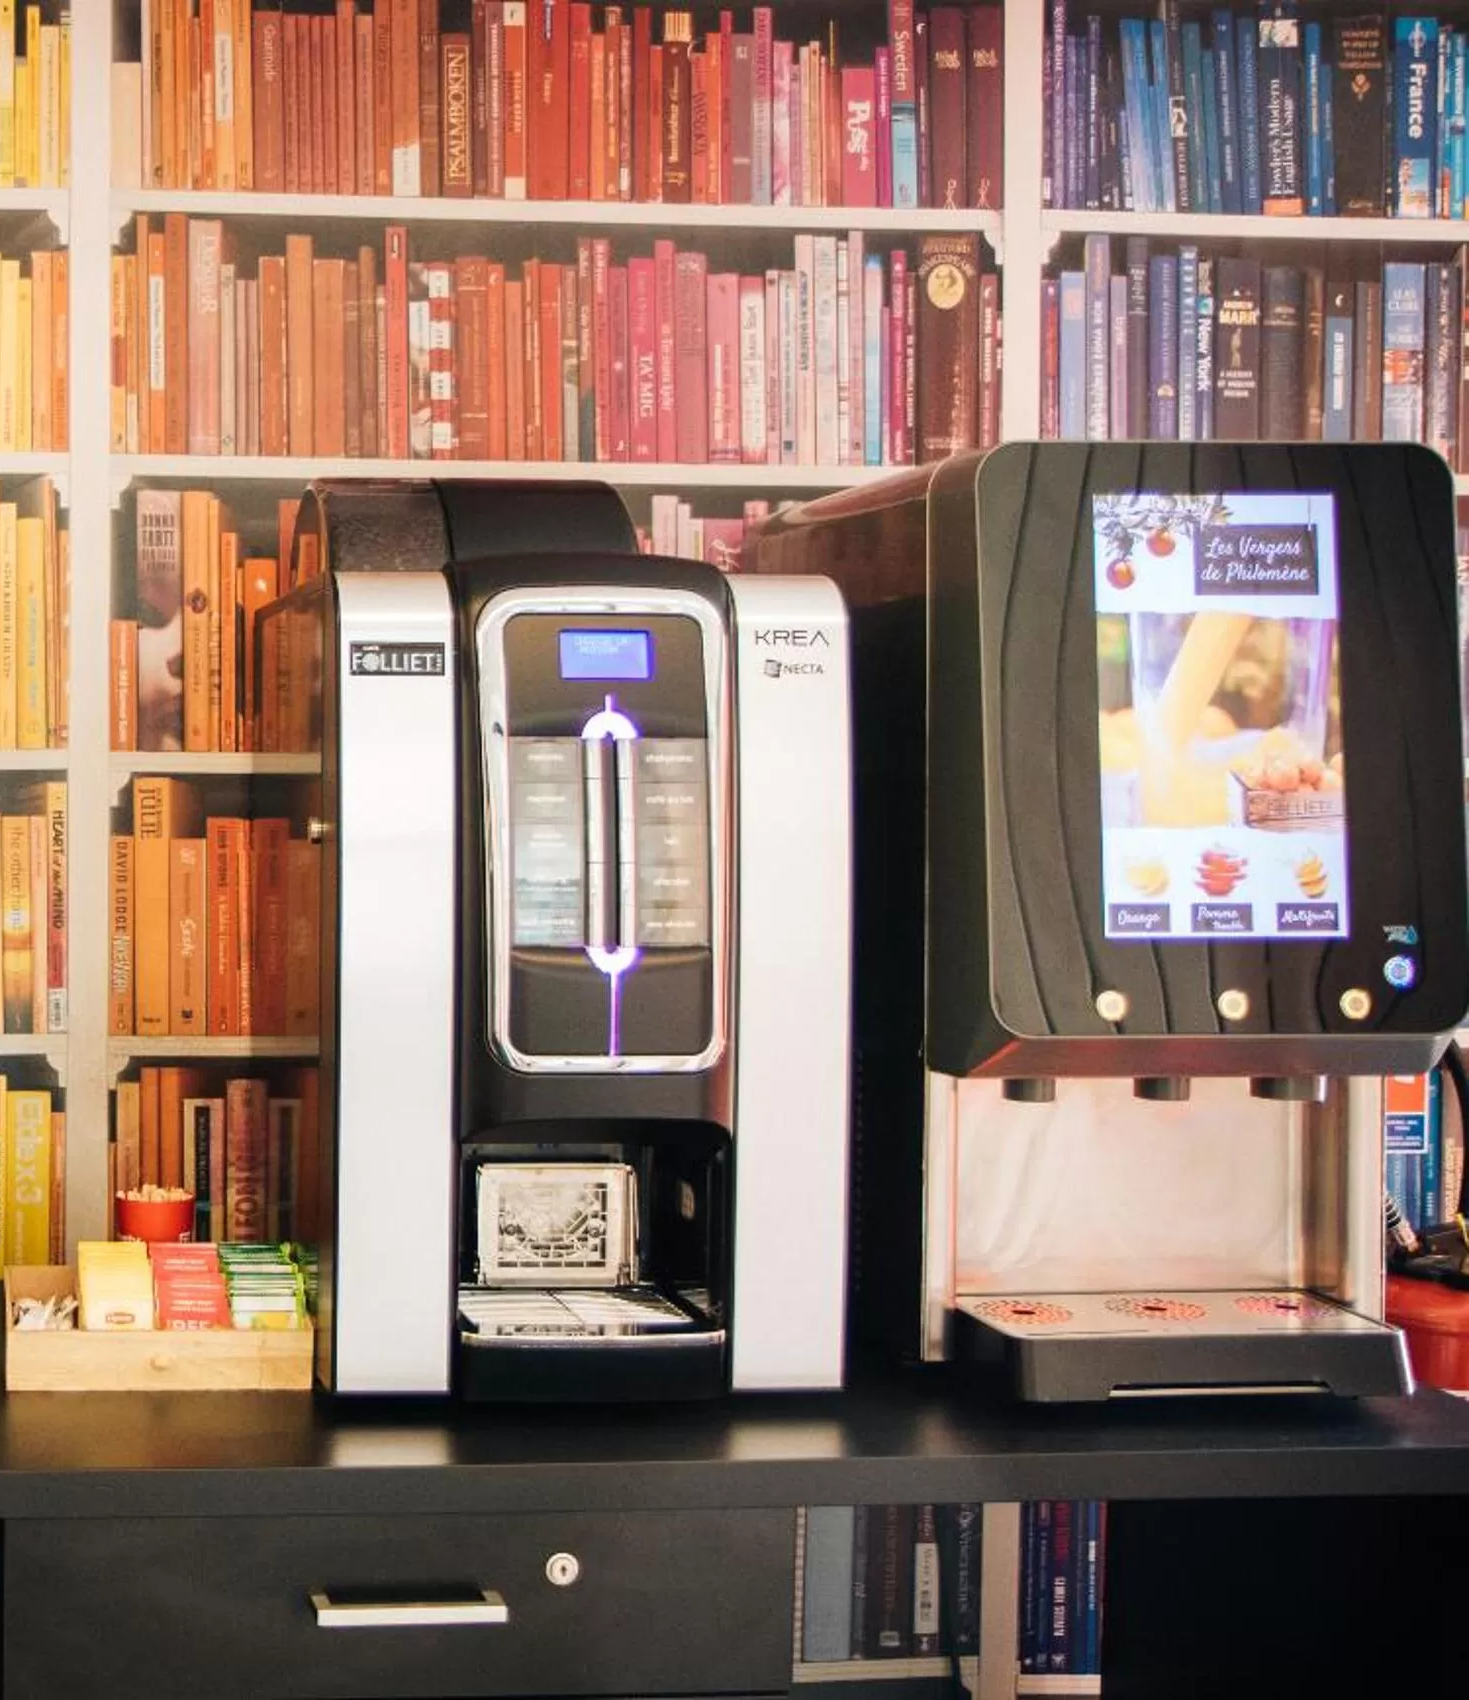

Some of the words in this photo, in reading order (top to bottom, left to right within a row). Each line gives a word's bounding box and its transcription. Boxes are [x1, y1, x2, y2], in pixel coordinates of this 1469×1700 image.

[895, 31, 909, 91] Sweden
[448, 52, 466, 178] PSALMBOKEN
[1408, 62, 1427, 139] France
[1197, 317, 1212, 353] New
[1197, 356, 1212, 392] York
[640, 382, 654, 418] MIG
[1204, 537, 1234, 559] Les
[1237, 535, 1304, 565] Vergers
[1200, 564, 1222, 582] de
[1225, 562, 1311, 584] Philomène
[754, 629, 830, 647] KREA
[352, 652, 433, 673] FOLLIET
[783, 663, 824, 675] NECTA
[139, 787, 157, 839] JULIE
[51, 809, 65, 856] HEART
[115, 841, 129, 883] DAVID
[51, 886, 65, 929] MIND
[115, 887, 129, 933] LODGE
[1117, 909, 1161, 930] Orange
